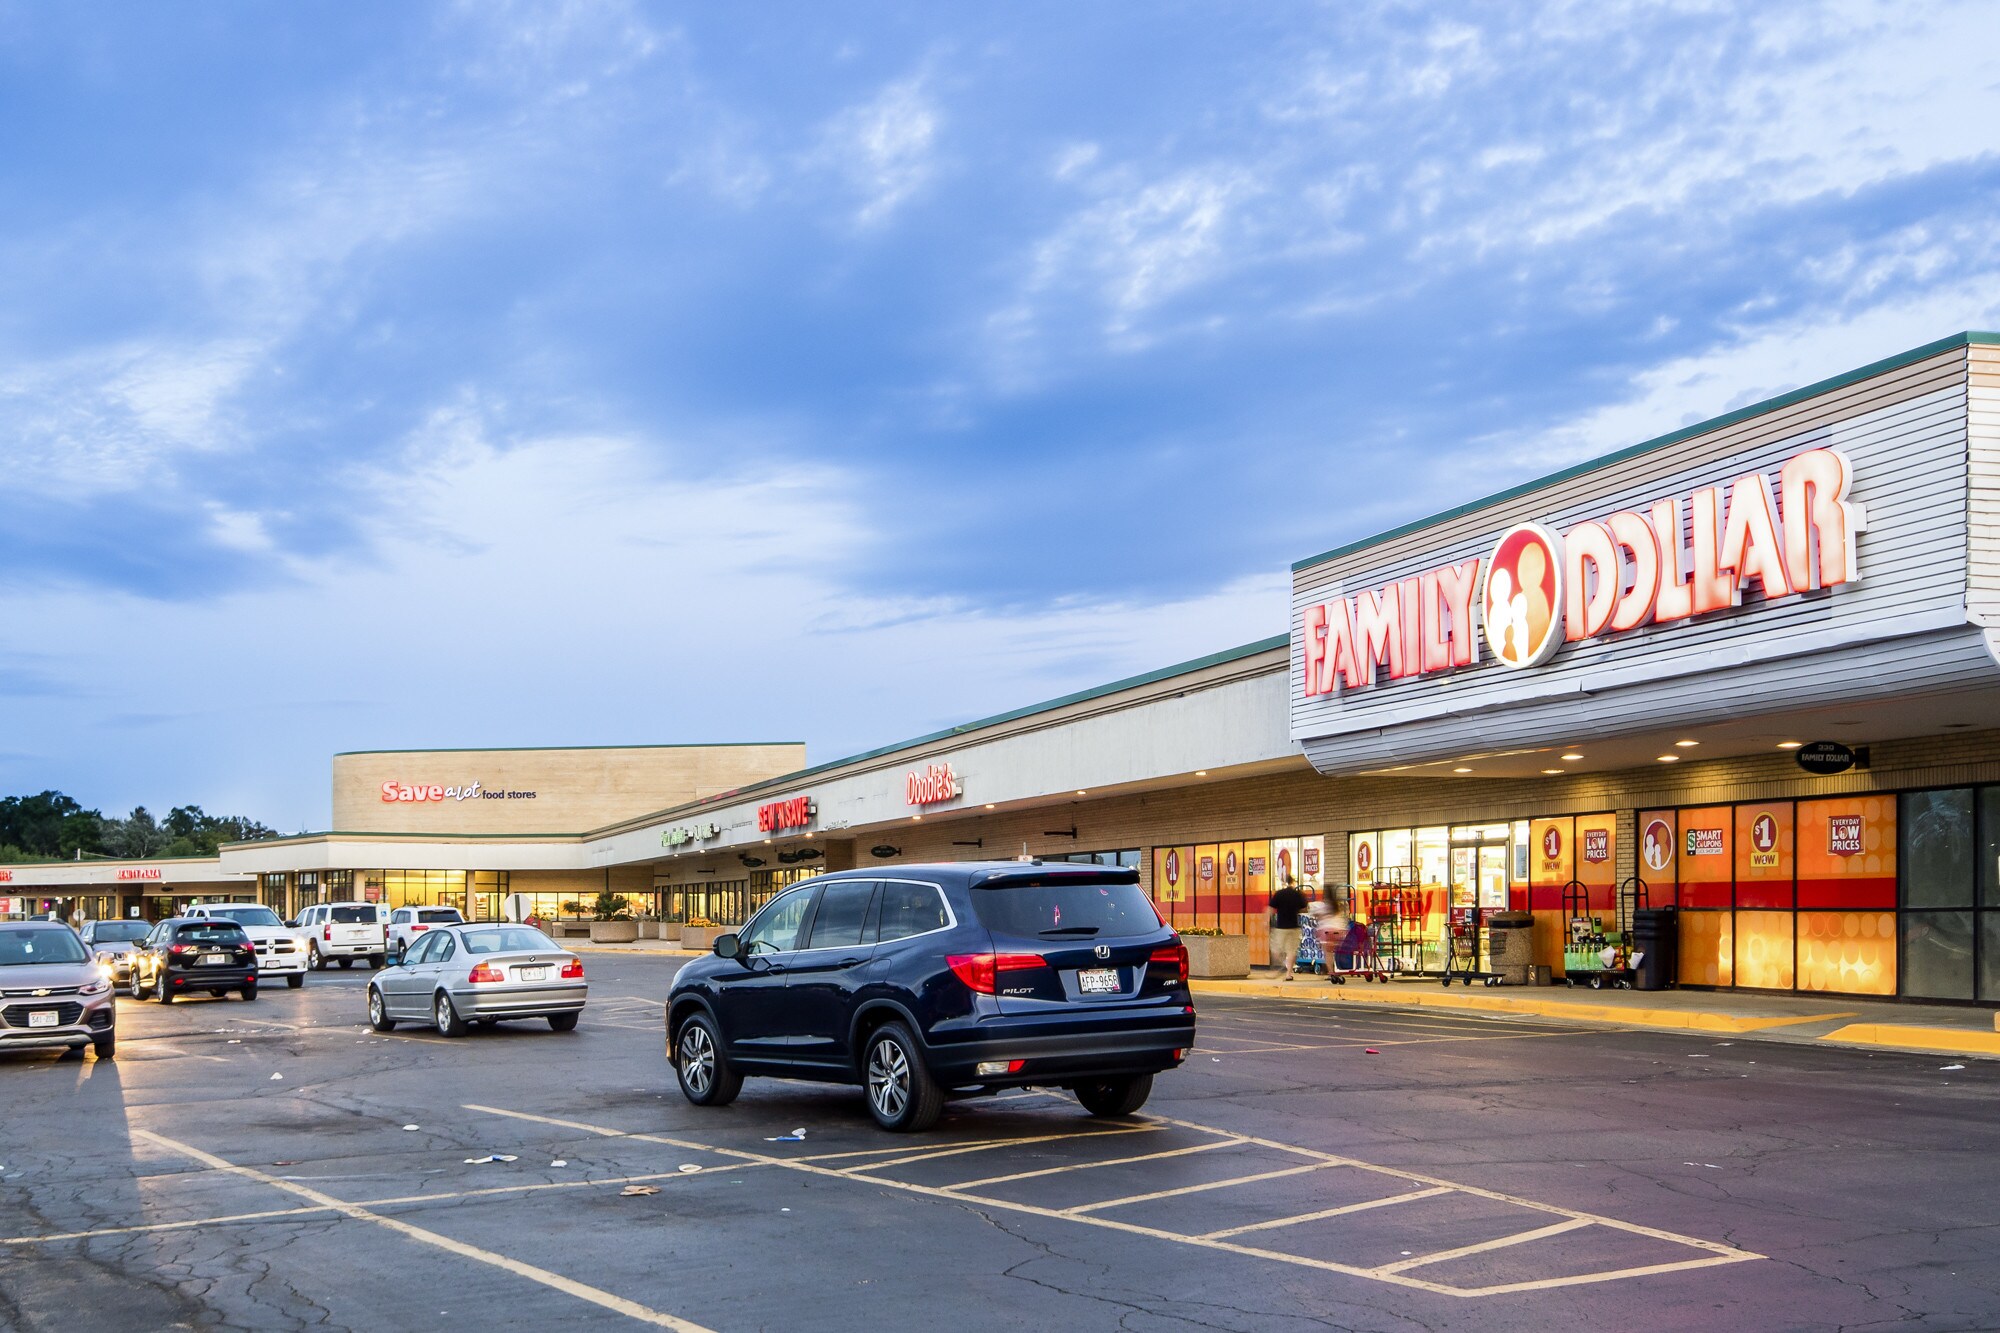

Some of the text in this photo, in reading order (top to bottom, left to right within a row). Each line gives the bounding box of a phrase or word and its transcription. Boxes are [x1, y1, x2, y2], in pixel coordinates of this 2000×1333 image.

[1304, 447, 1854, 697] FAMILY DOLLAR
[382, 781, 444, 803] Save
[482, 790, 505, 799] food
[507, 790, 537, 799] stores
[906, 763, 953, 805] Doobie's
[758, 801, 775, 832] SEW
[785, 796, 809, 828] SAVE
[1696, 830, 1722, 840] SMART
[1832, 840, 1860, 850] PRICES
[1586, 850, 1606, 859] PRICES
[1002, 987, 1034, 995] PILOT
